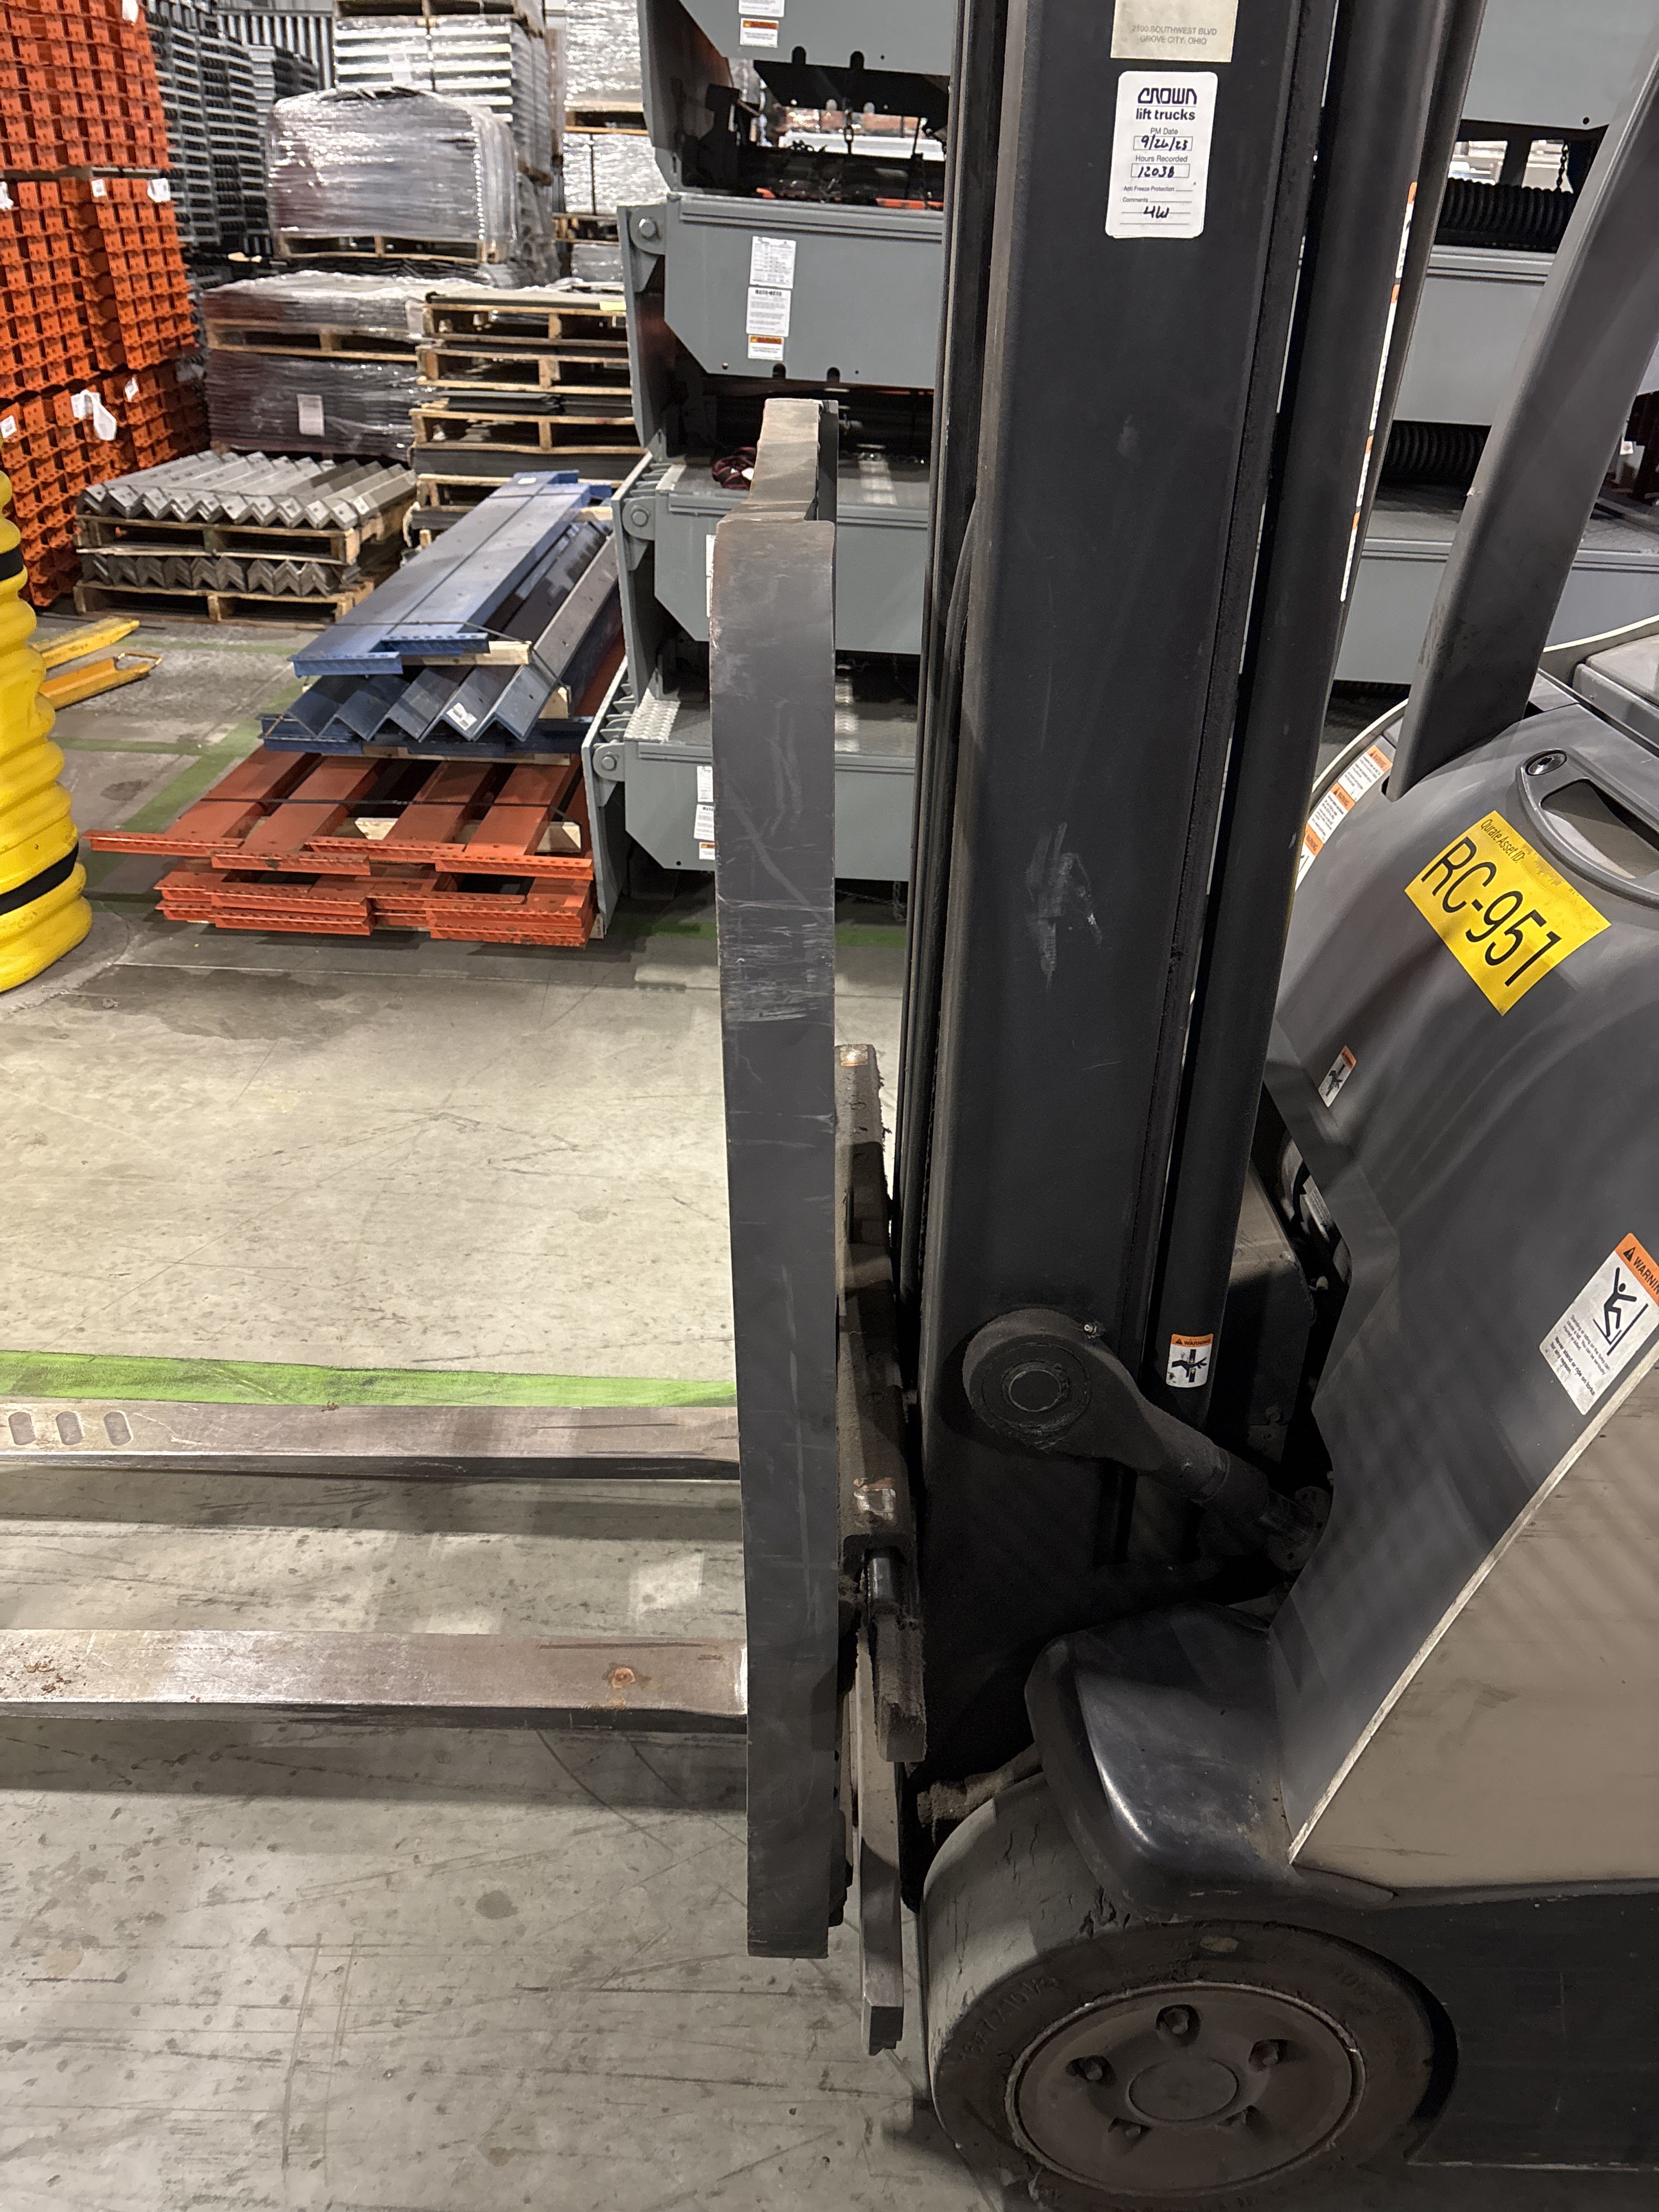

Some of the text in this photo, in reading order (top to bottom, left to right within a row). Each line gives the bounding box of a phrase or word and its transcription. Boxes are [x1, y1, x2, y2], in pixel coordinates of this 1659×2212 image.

[1132, 25, 1149, 33] 2100
[1150, 25, 1196, 35] SOUTHWEST
[1138, 88, 1197, 105] CROWN
[1135, 108, 1195, 121] lift trucks
[1481, 819, 1503, 841] Qurate
[1496, 836, 1519, 856] Asset
[1421, 836, 1562, 987] RC-951
